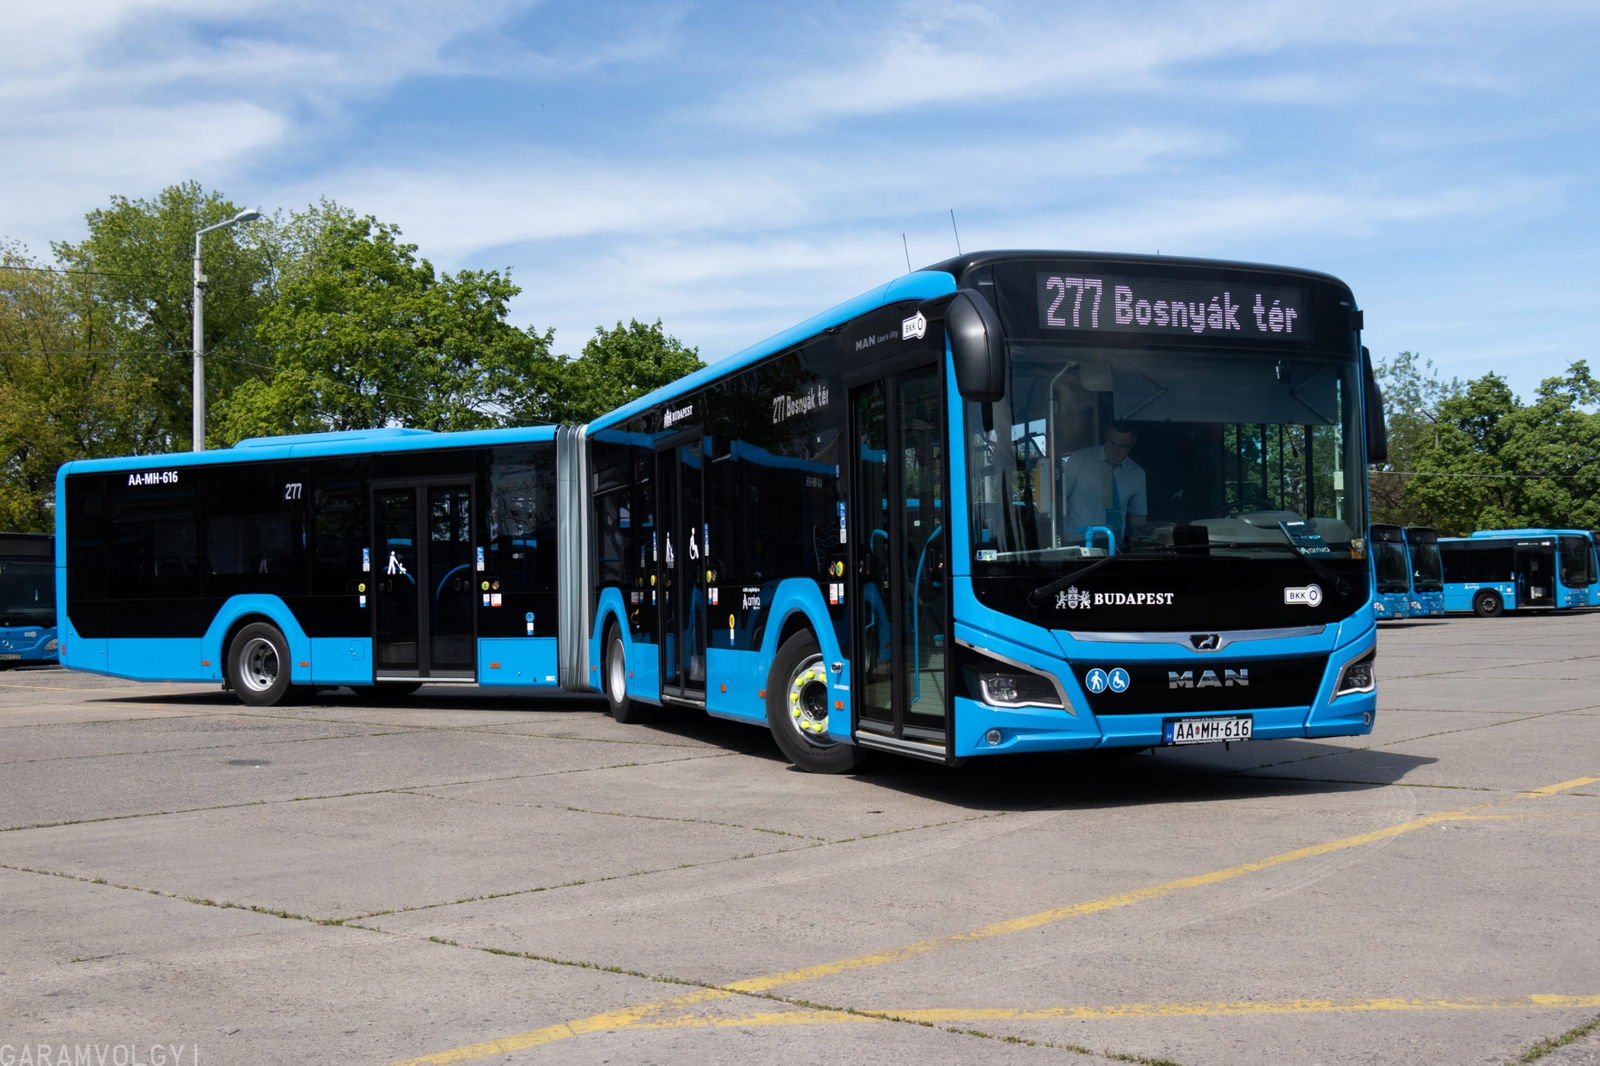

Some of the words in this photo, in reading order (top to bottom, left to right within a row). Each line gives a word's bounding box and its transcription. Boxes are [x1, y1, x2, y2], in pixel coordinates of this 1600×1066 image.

[1046, 276, 1103, 329] 277
[1114, 285, 1241, 334] Bosnyák
[1252, 293, 1298, 333] tér
[855, 335, 876, 351] MAN
[772, 394, 786, 424] 277
[128, 471, 179, 486] AA-MH-616
[285, 482, 303, 500] 277
[1093, 592, 1174, 605] BUDAPEST
[1289, 592, 1306, 600] BKK
[1168, 668, 1249, 689] MAN
